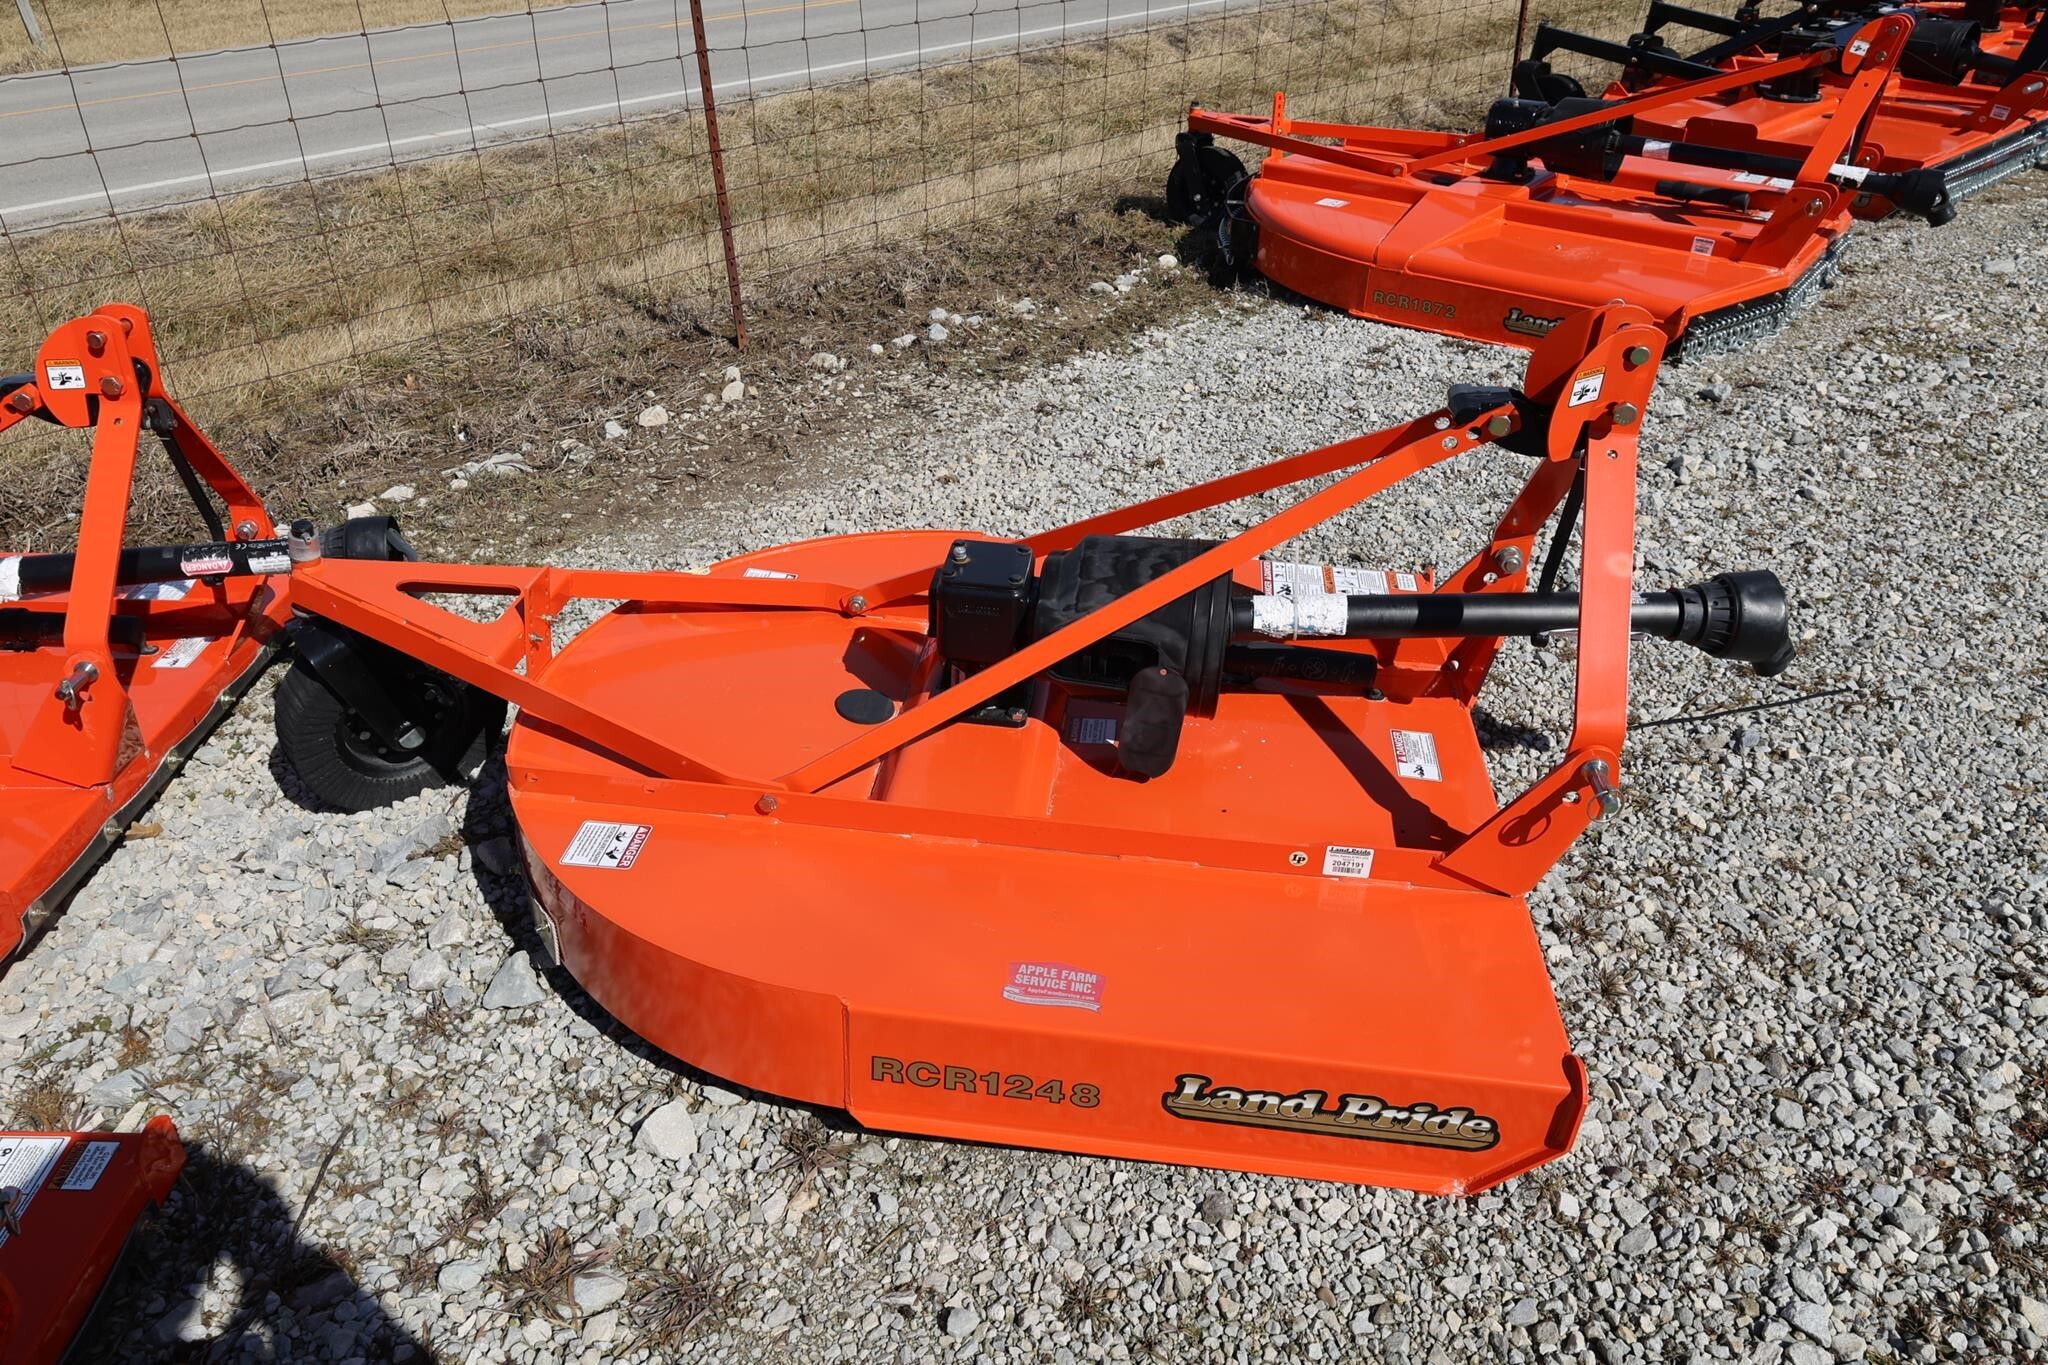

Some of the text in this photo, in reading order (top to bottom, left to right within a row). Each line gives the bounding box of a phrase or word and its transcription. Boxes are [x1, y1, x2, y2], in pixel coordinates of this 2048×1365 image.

[1373, 291, 1456, 318] RCR1872
[186, 561, 218, 572] DANGER
[619, 833, 644, 867] DANGER
[1332, 860, 1364, 868] 2047191
[1015, 974, 1096, 994] SERVICE INC.
[1018, 964, 1097, 983] APPLE FARM
[871, 1056, 1101, 1108] RCR1248
[1166, 1074, 1494, 1139] Land Pride
